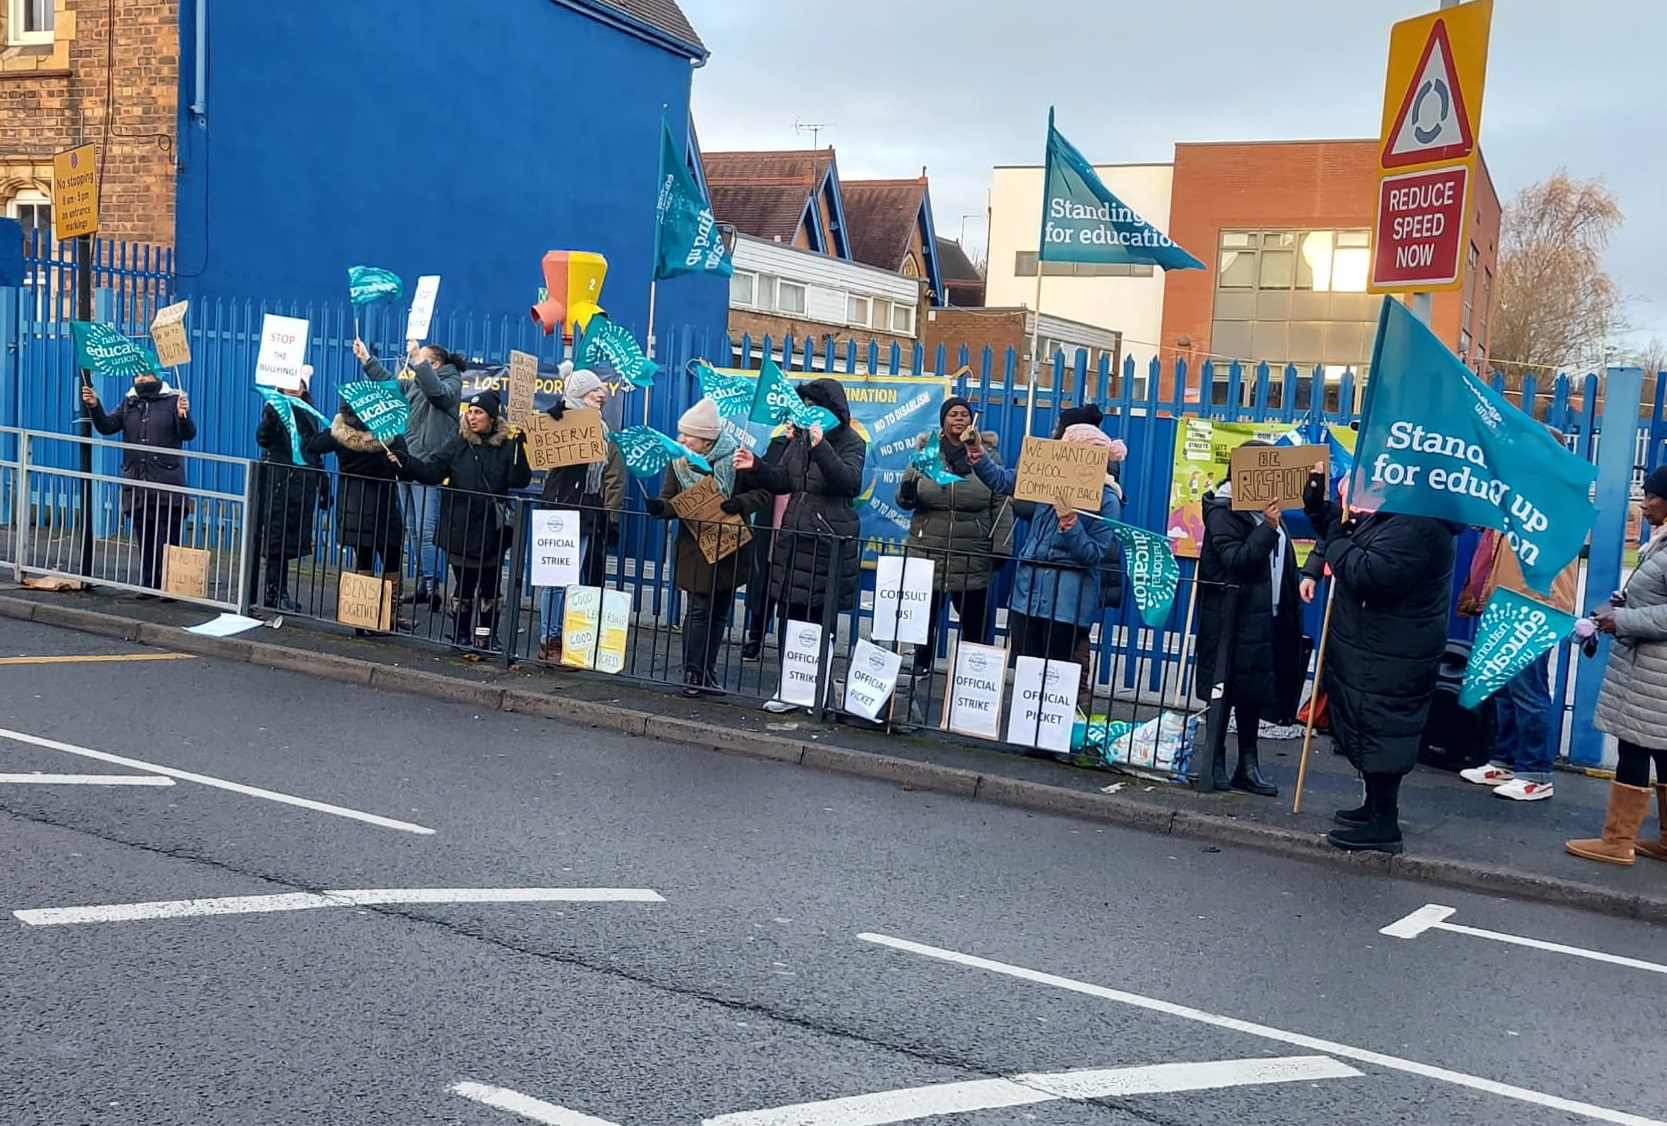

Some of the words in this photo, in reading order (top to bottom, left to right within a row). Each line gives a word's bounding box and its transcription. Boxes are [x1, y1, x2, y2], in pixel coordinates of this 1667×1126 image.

[57, 178, 65, 190] No
[67, 171, 94, 188] stopping
[1389, 181, 1455, 211] REDUCE
[69, 206, 91, 218] entrance
[1050, 198, 1146, 226] Standing
[66, 219, 88, 230] markings
[1392, 212, 1445, 241] SPEED
[1044, 222, 1074, 243] for
[1079, 225, 1181, 248] educatio
[1395, 243, 1435, 268] NOW
[588, 278, 596, 291] 2
[270, 332, 296, 345] STOP
[111, 354, 138, 366] union
[274, 351, 287, 360] THE
[259, 362, 298, 377] BULLYING!
[473, 376, 509, 391] LOST
[368, 413, 396, 430] union
[524, 415, 549, 433] WE
[884, 413, 896, 427] TO
[534, 426, 597, 448] DESERVE
[533, 440, 604, 467] BETTER!
[880, 445, 893, 457] NO
[892, 440, 904, 452] TO
[1025, 437, 1046, 458] WE
[1051, 442, 1086, 463] WANT
[1085, 450, 1107, 466] OUR
[1258, 452, 1281, 467] BE
[883, 471, 894, 484] NO
[1022, 460, 1068, 479] SCHOOL
[1371, 453, 1421, 487] for
[1018, 479, 1075, 499] COMMUNITY
[1076, 487, 1100, 502] BACK
[1511, 494, 1548, 533] up
[537, 538, 576, 549] OFFICIAL
[541, 556, 571, 566] STRIKE
[1152, 541, 1165, 588] national
[1131, 530, 1151, 611] ducation
[342, 576, 390, 603] BENSN
[879, 589, 928, 602] CONSULT
[571, 593, 593, 607] GOOD
[895, 609, 913, 620] US!
[570, 632, 592, 646] GOOD
[854, 670, 888, 693] OFFICIAL
[956, 675, 997, 692] OFFICIAL
[850, 688, 876, 708] PICKET
[957, 697, 990, 712] STRIKE
